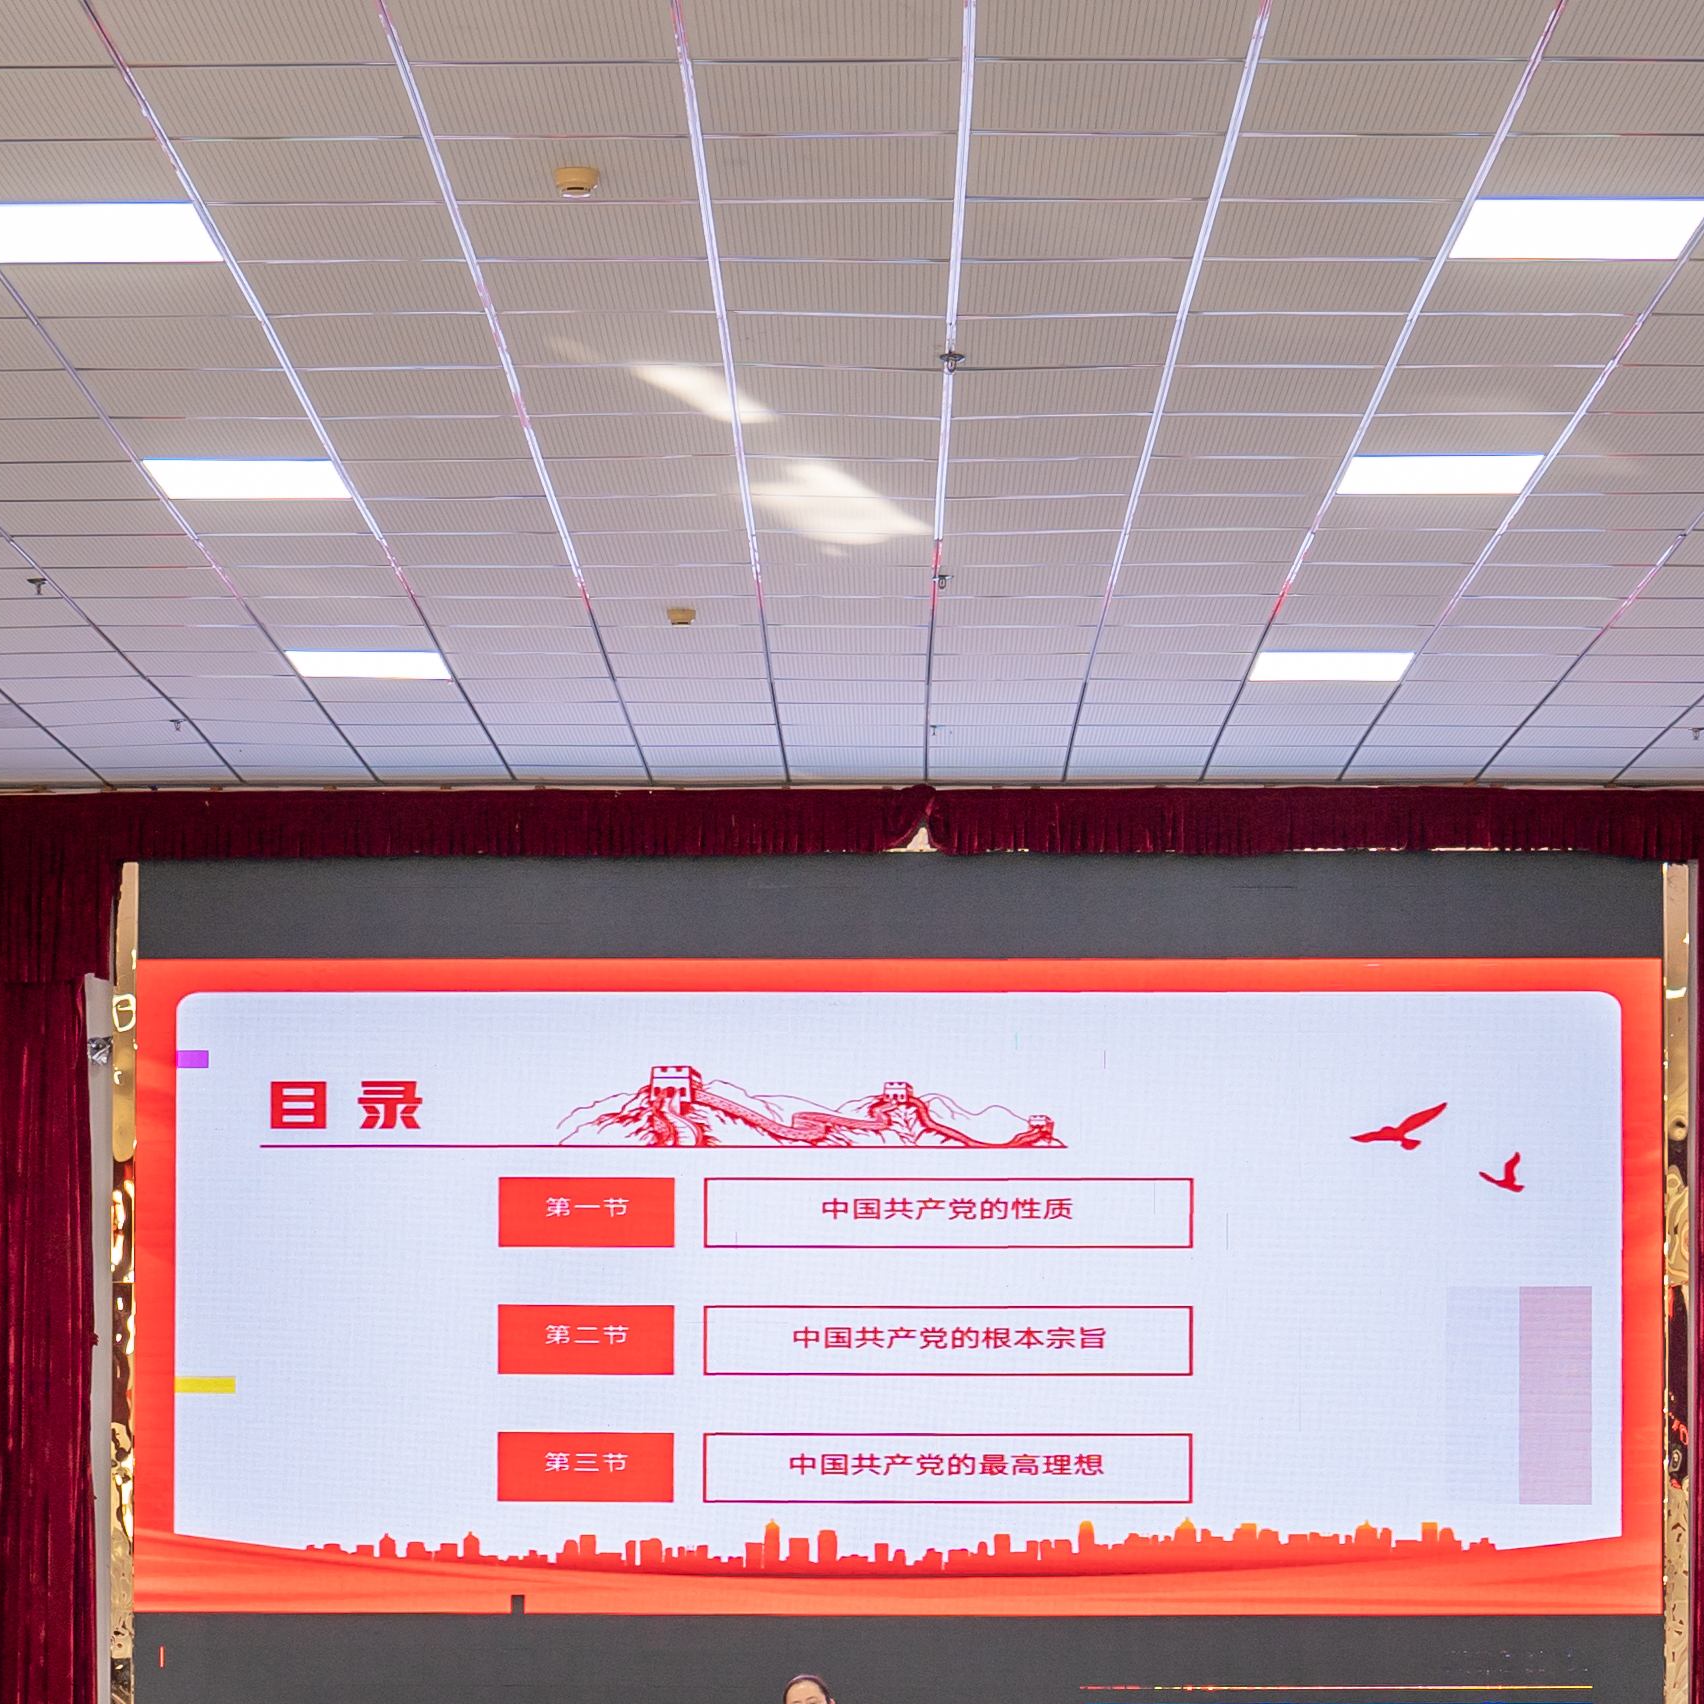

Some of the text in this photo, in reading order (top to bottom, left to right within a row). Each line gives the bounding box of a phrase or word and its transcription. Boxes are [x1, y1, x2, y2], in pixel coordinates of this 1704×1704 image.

[270, 1081, 423, 1129] 目录
[546, 1198, 628, 1216] 第一节
[822, 1198, 1070, 1220] 中国共产党的性质
[546, 1325, 628, 1344] 第二节
[793, 1327, 1106, 1349] 中国共产党的根本宗旨
[545, 1453, 627, 1472] 第三节
[789, 1453, 1102, 1476] 中国共产党的最高理想
